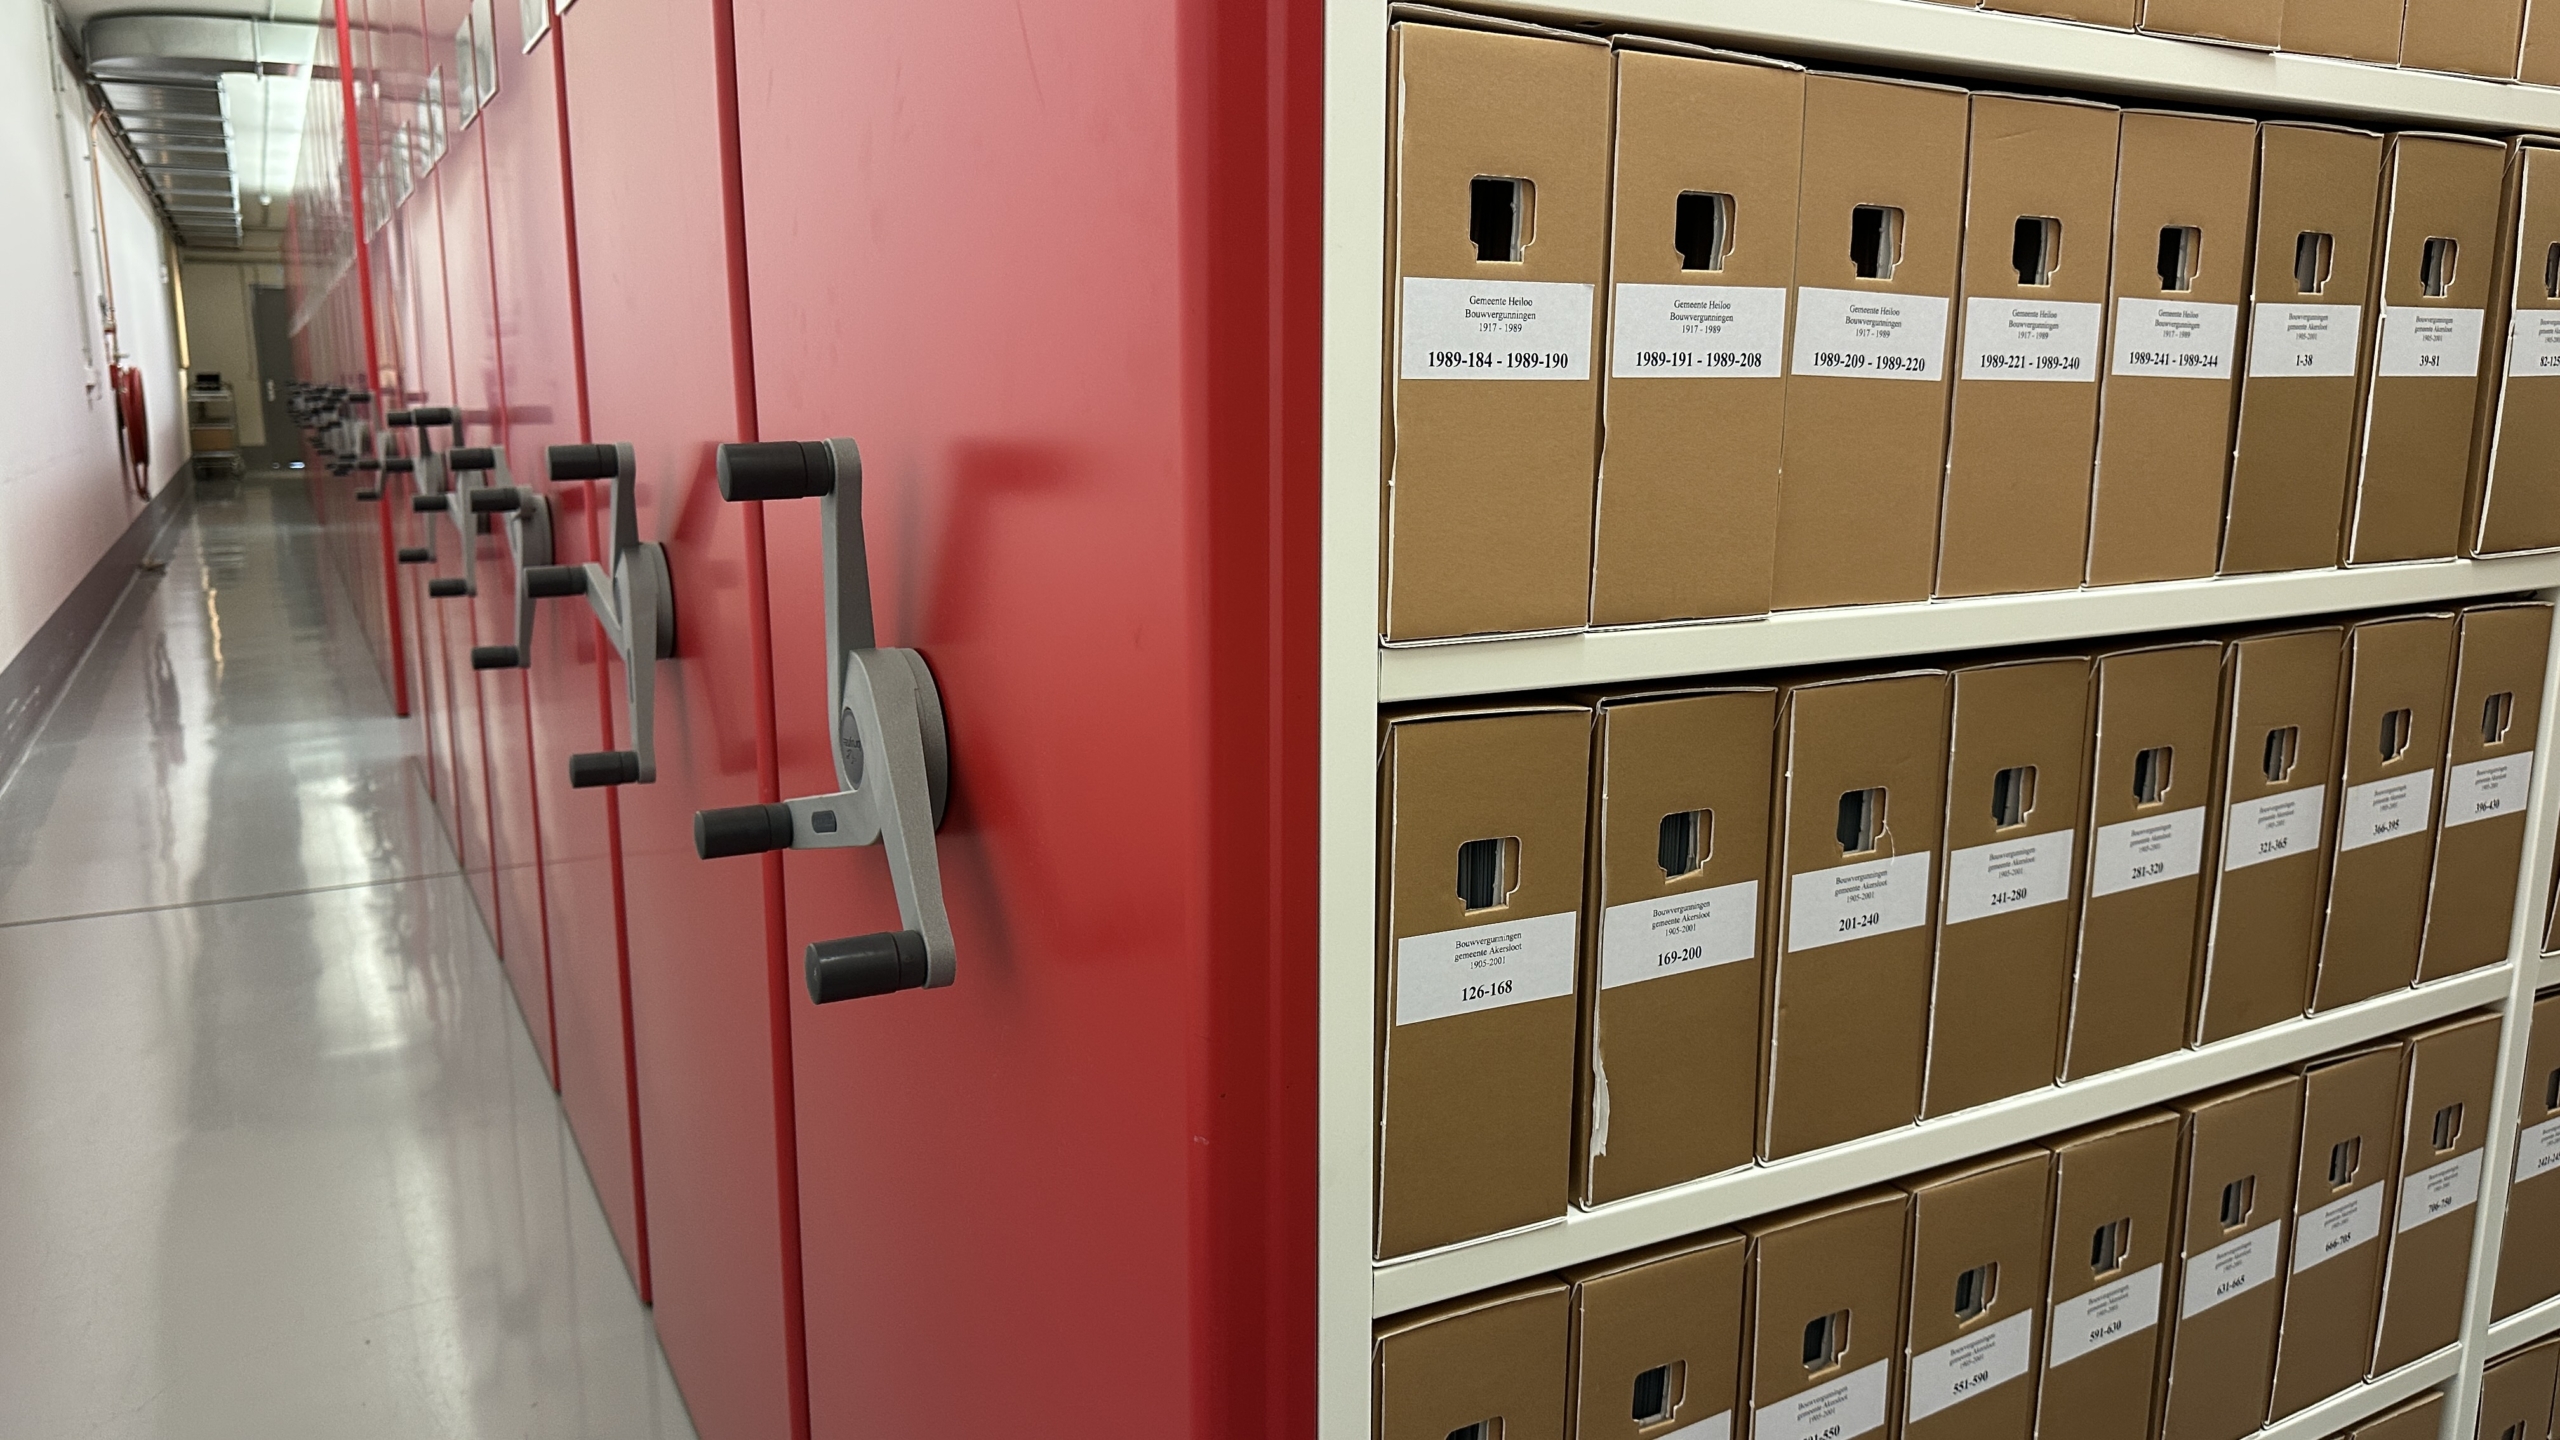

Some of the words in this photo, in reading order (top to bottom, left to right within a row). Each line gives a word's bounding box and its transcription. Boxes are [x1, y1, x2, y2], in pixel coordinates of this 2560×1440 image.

[1469, 296, 1507, 306] Gemeente
[1508, 297, 1533, 307] Heiloo
[1674, 300, 1707, 309] Gemeente
[1708, 300, 1731, 310] Heiloo
[1465, 309, 1536, 321] Bouwvergunningen
[1670, 312, 1734, 323] Bouwvergunningen
[1850, 304, 1879, 315] Gemeente
[1880, 307, 1900, 316] Heiloo
[2012, 309, 2039, 318] Gemeente
[2039, 310, 2058, 319] Heiloo
[1479, 323, 1497, 332] 1917
[1504, 323, 1522, 332] 1989
[1682, 325, 1698, 333] 1917
[1705, 325, 1721, 334] 1989
[1845, 316, 1902, 329] Bouwvergunningen
[2008, 320, 2059, 331] Bouwvergunningen
[1856, 328, 1870, 337] 1917
[1876, 329, 1891, 338] 1989
[2036, 332, 2049, 340] 1989
[1429, 351, 1492, 367] 1989-184
[1507, 352, 1569, 369] 1989-190
[1636, 351, 1692, 367] 1989-191
[1706, 352, 1762, 368] 1989-208
[1814, 352, 1865, 368] 1989-209
[1876, 355, 1925, 372] 1989-220
[1981, 354, 2025, 369] 1989-221
[2036, 356, 2080, 370] 1989-240
[2130, 351, 2169, 366] 1989-241
[2179, 353, 2218, 367] 1989-244
[2296, 354, 2313, 366] 1-38
[2419, 355, 2440, 367] 39-81
[2259, 837, 2288, 854] 321-365
[2131, 861, 2164, 880] 281-320
[1991, 887, 2027, 906] 241-280
[1653, 901, 1711, 918] Bouwvergunningen
[1651, 918, 1680, 930] gemeente
[1681, 910, 1711, 922] Akersloot
[1839, 912, 1880, 932] 201-240
[1665, 923, 1696, 937] 1905-2001
[1455, 932, 1522, 949] Bouwvergunningen
[1454, 949, 1487, 962] gemeente
[1489, 943, 1522, 955] Akersloot
[1658, 946, 1702, 967] 169-200
[1470, 956, 1506, 969] 1905-2001
[1461, 979, 1513, 1001] 126-168
[2216, 1274, 2245, 1296] 631-665
[2089, 1319, 2122, 1342] 591-630
[1953, 1370, 1988, 1396] 551-590
